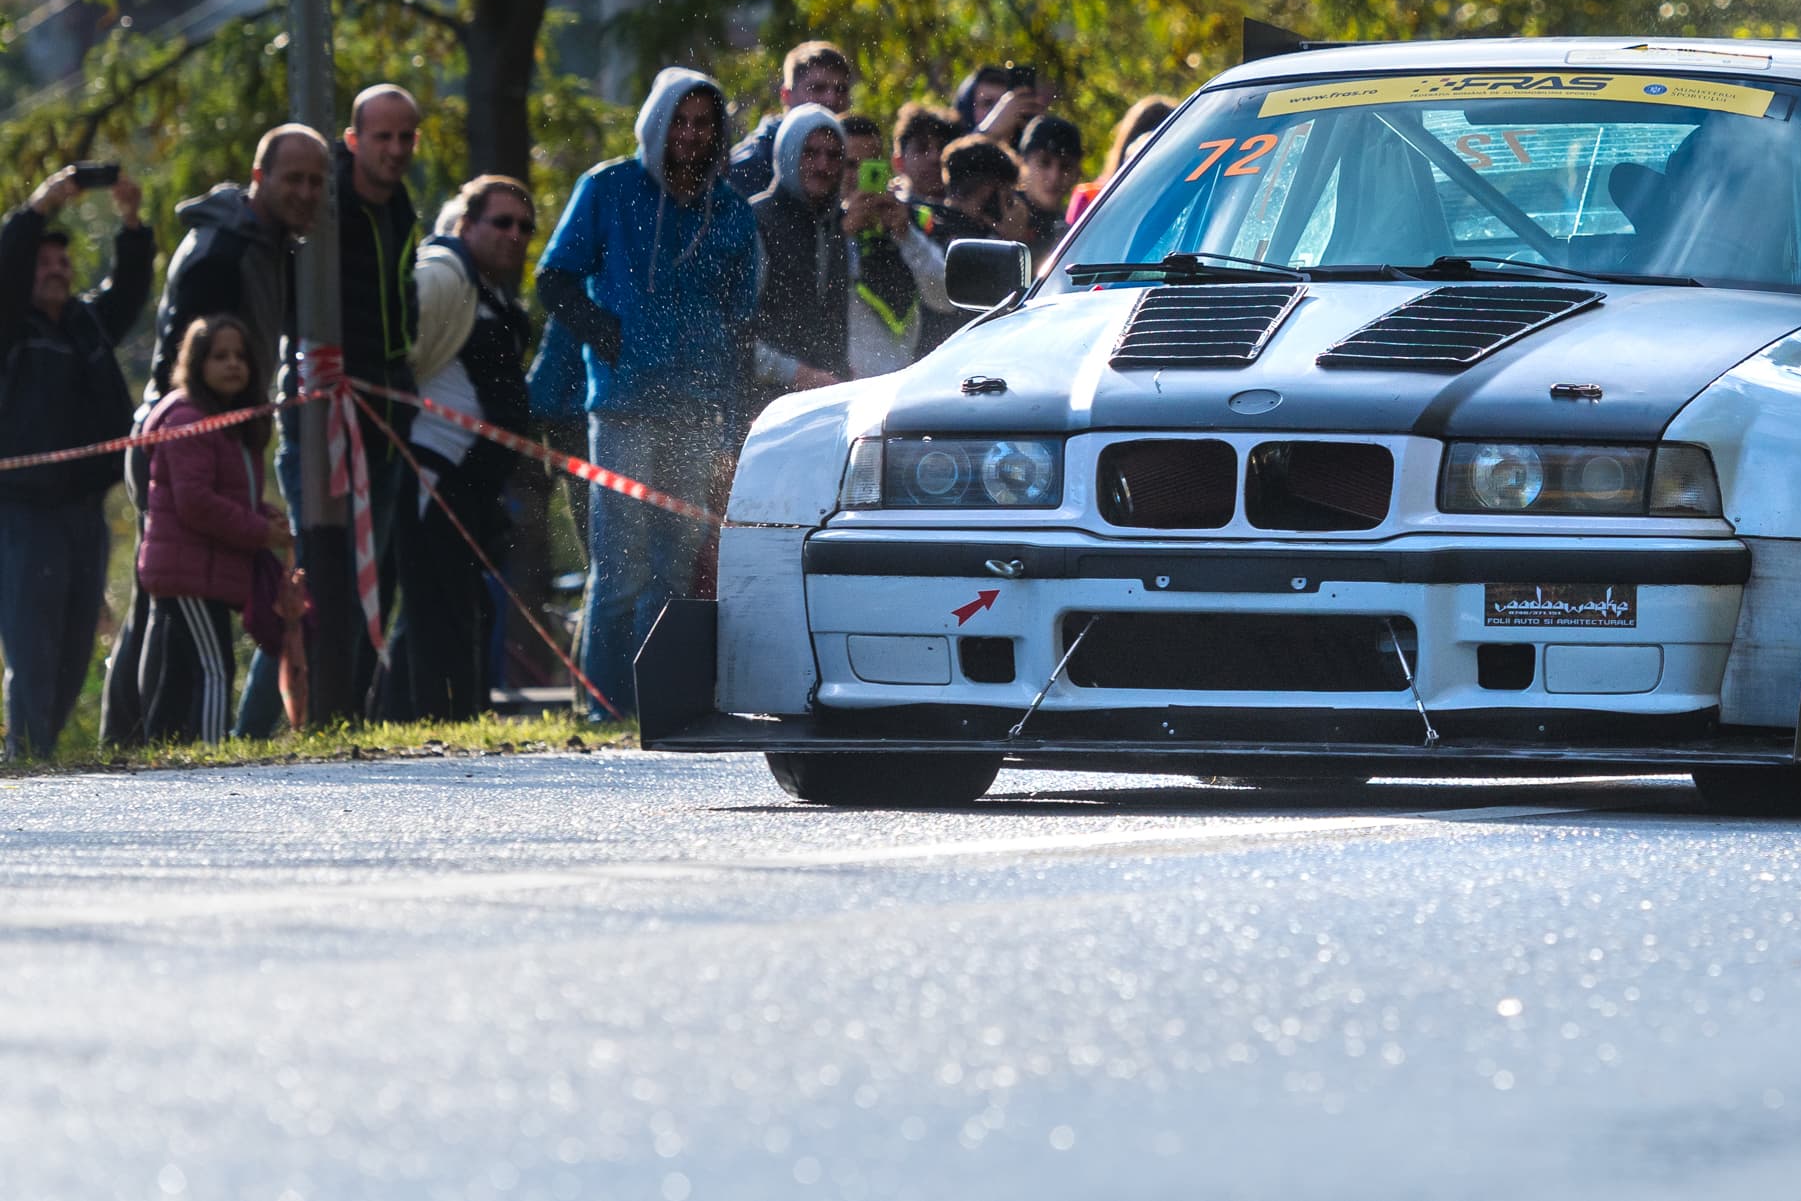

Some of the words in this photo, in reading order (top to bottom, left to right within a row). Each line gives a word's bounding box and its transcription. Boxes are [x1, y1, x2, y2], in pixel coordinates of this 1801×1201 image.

[1289, 89, 1379, 103] www.fras.ro
[1184, 133, 1279, 183] 72
[1487, 617, 1511, 625] FOLII
[1514, 617, 1540, 625] AUTO
[1556, 618, 1635, 627] ARHITECTURALE
